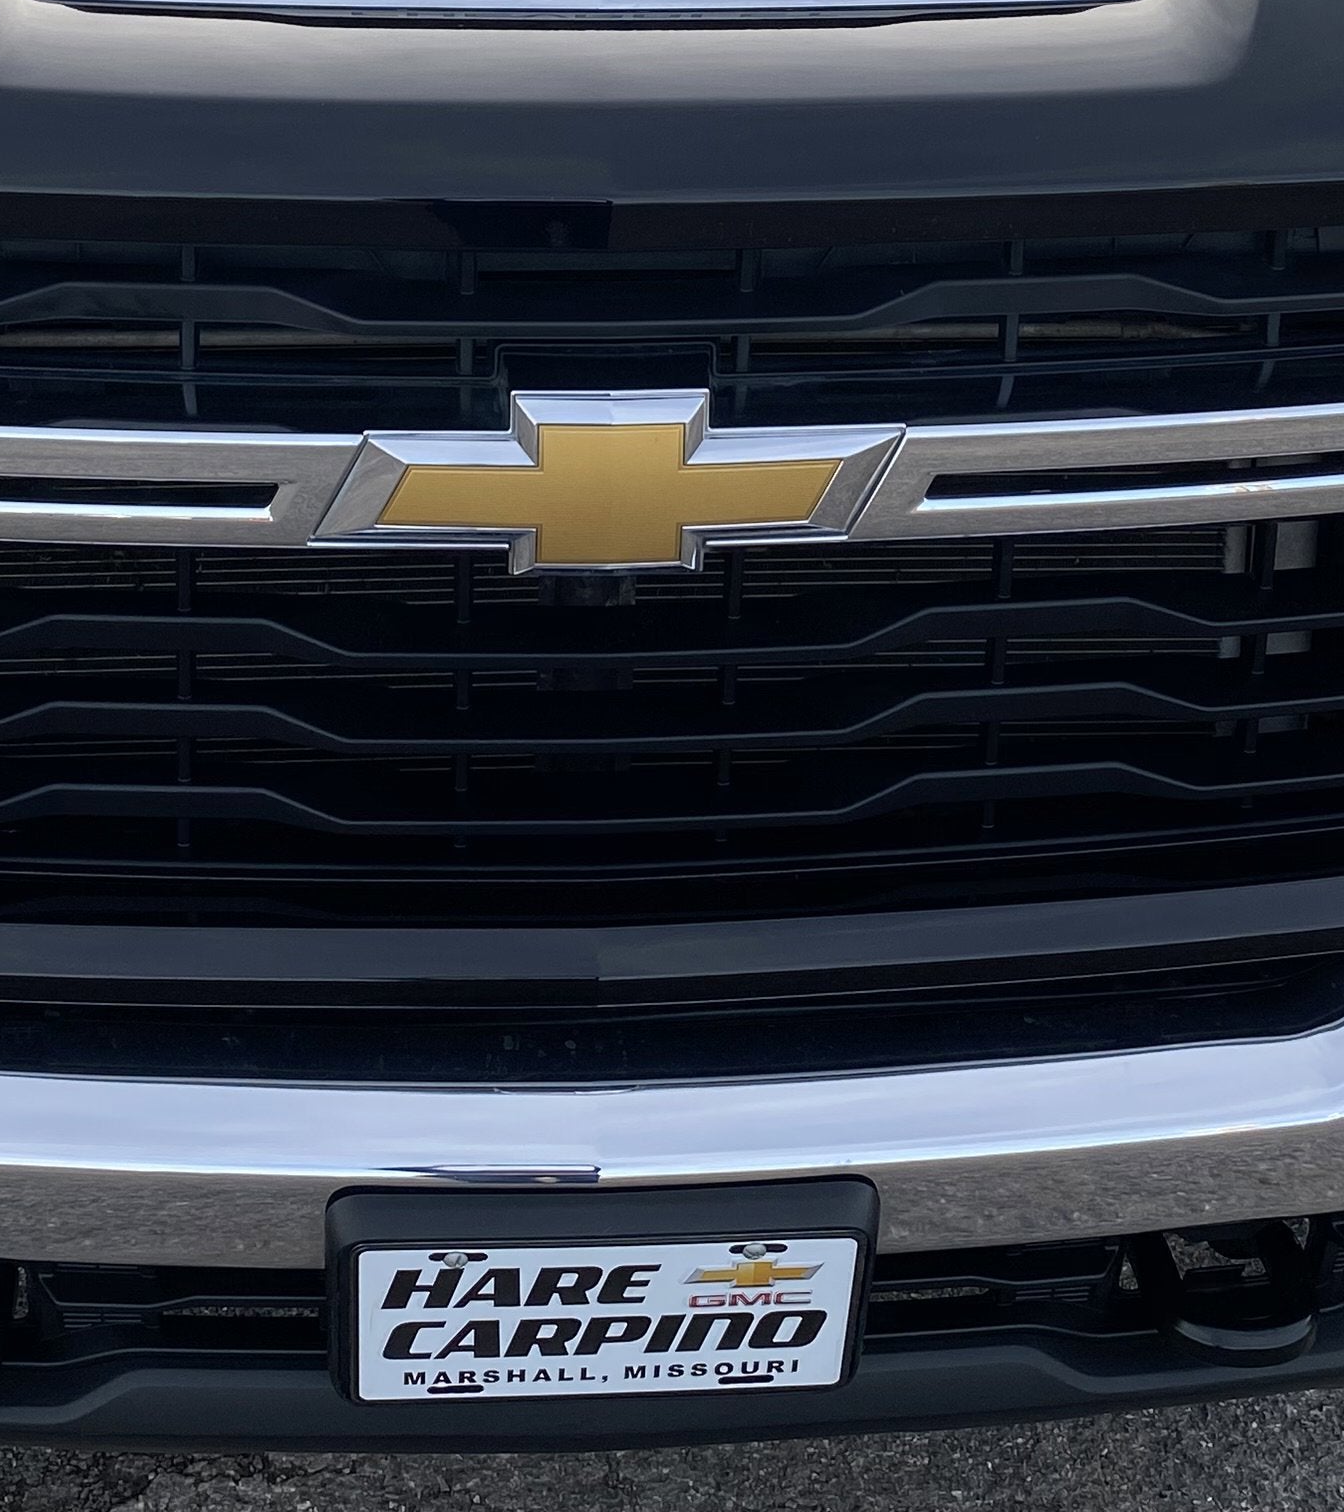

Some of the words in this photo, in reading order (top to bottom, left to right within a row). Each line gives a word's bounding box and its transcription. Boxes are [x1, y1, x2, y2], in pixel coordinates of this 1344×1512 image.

[381, 1263, 662, 1310] HARE
[687, 1289, 814, 1308] GMC
[382, 1309, 828, 1360] CARPINO
[403, 1366, 609, 1385] MARSHALL,
[623, 1358, 800, 1379] MISSOURI
